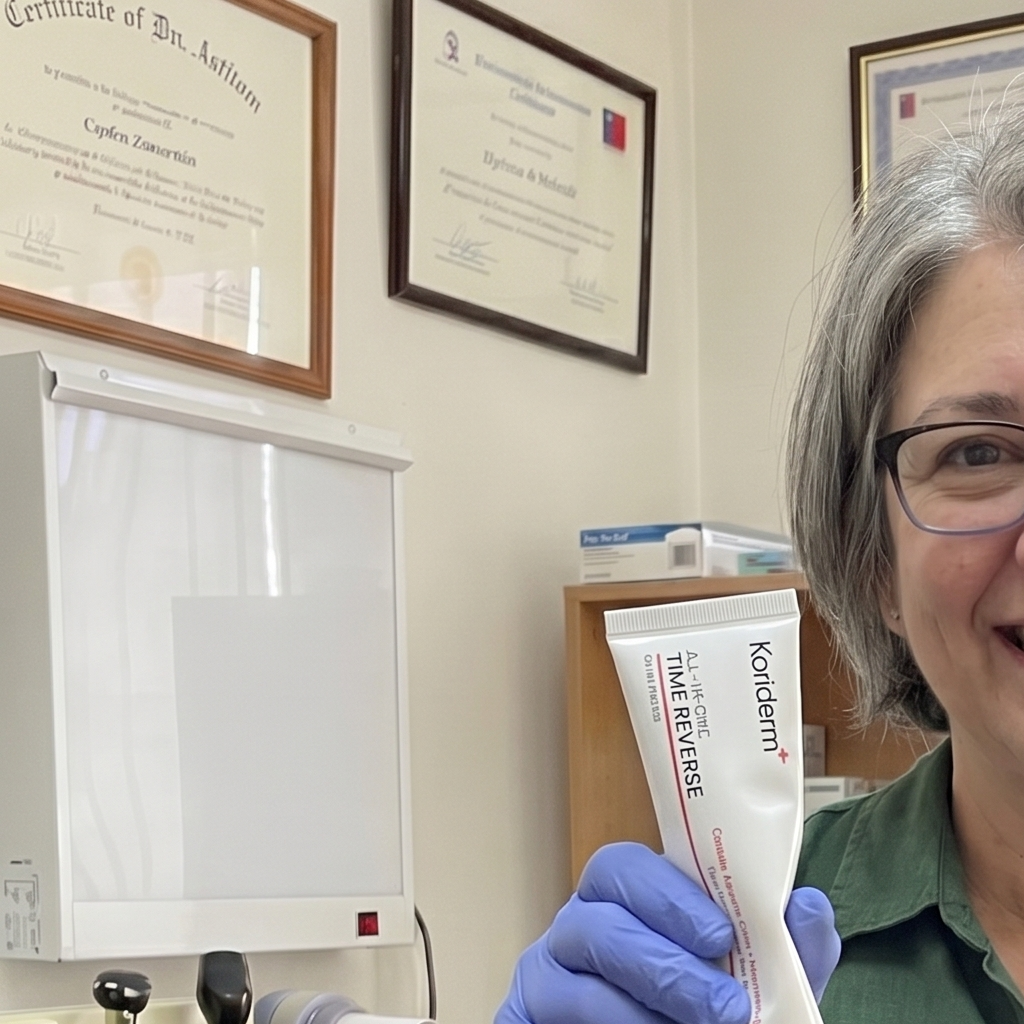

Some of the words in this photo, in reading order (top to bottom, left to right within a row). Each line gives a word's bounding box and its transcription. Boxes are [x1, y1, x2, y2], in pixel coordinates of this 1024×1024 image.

[124, 7, 145, 29] of
[666, 652, 688, 702] TIME
[674, 706, 704, 799] REVERSE
